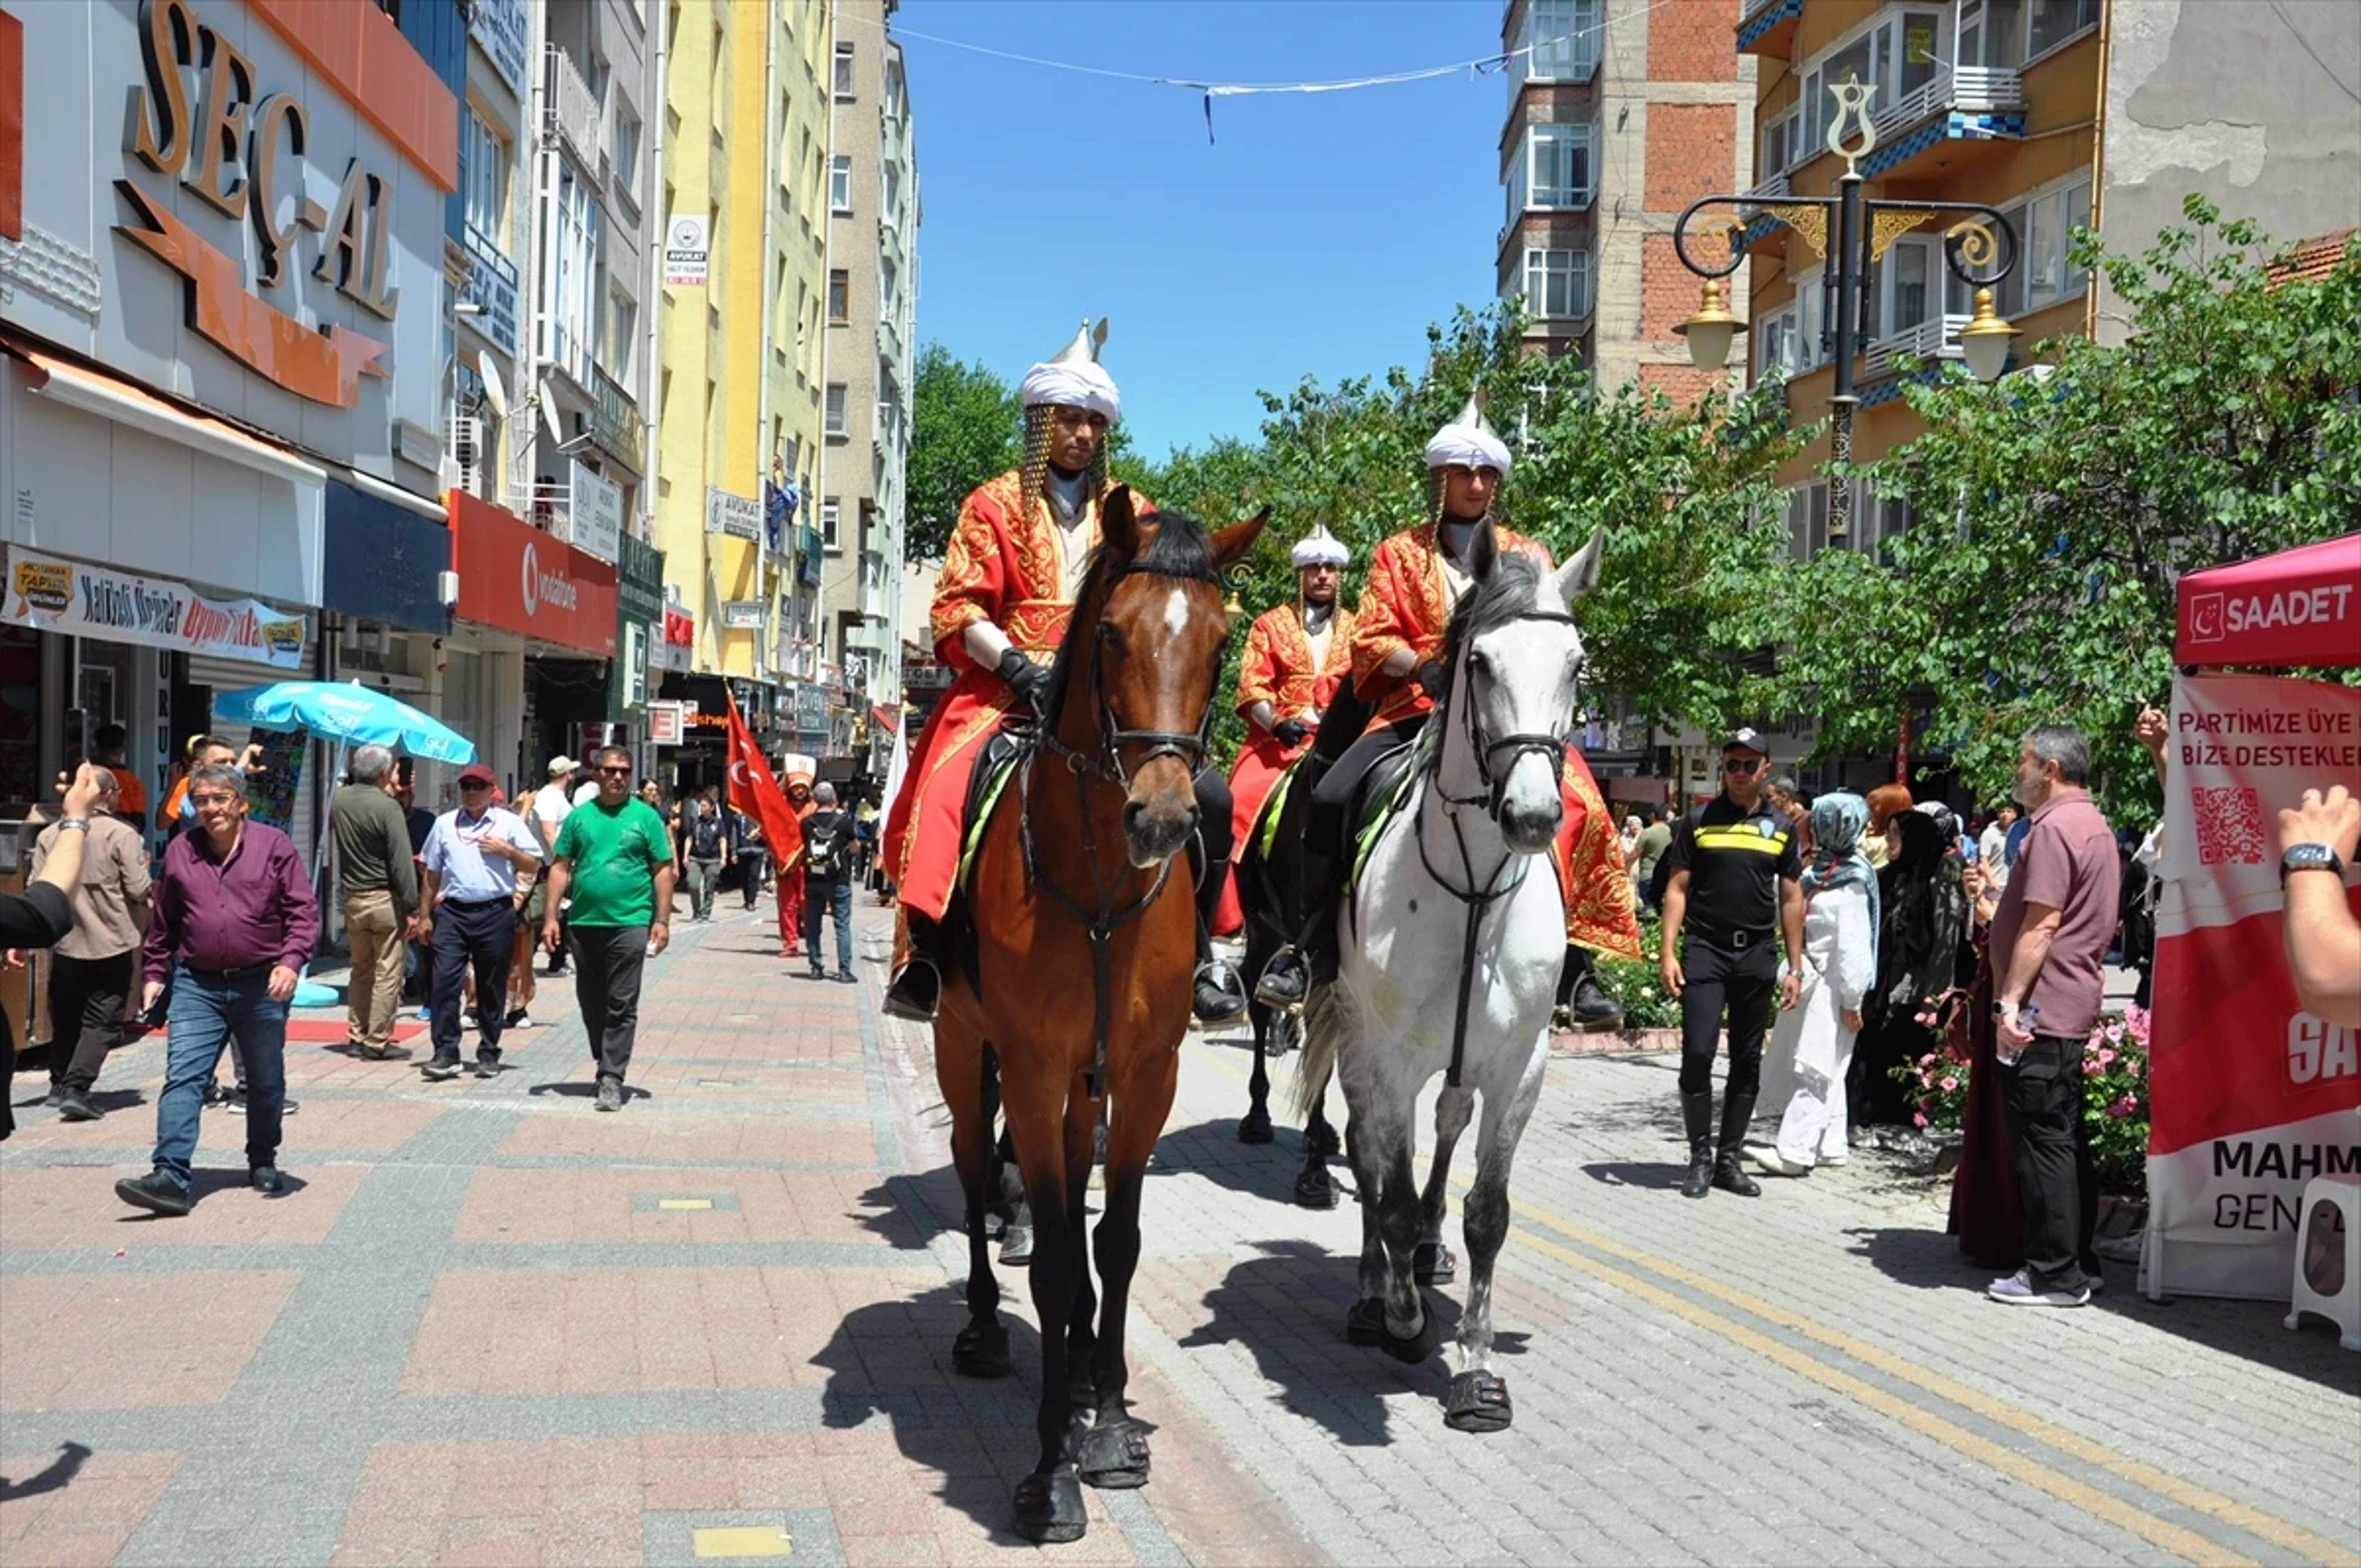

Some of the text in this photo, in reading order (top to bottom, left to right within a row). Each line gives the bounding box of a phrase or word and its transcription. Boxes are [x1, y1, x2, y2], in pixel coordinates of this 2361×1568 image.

[122, 0, 400, 322] SEÇ-AL
[670, 251, 704, 261] AVUKAT
[726, 496, 761, 517] AVUKAT
[539, 566, 577, 611] vodafone
[2226, 584, 2354, 632] SAADET
[653, 710, 672, 737] E
[2178, 708, 2302, 734] PARTİMİZE
[2308, 708, 2352, 734] ÜYE
[2181, 740, 2361, 766] BİZE DESTEKLE
